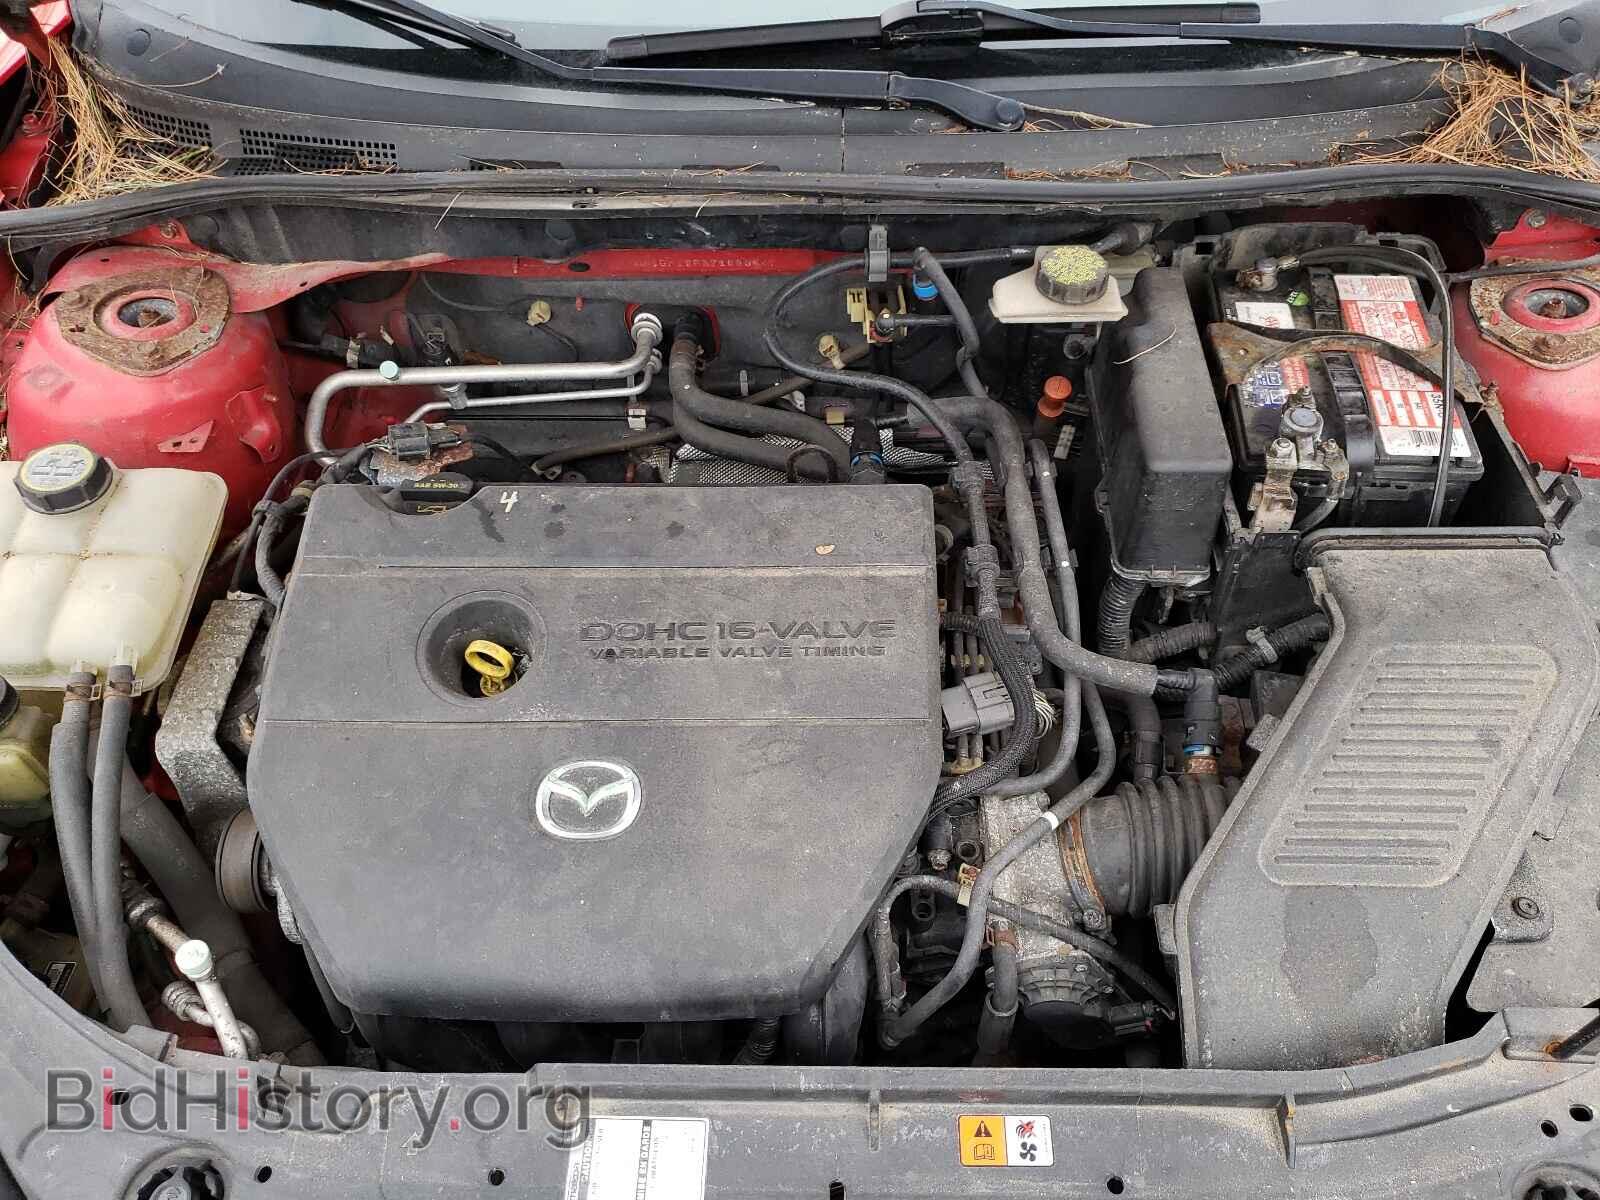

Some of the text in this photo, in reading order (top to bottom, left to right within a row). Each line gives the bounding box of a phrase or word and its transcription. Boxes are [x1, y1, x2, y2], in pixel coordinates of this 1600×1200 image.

[500, 490, 519, 513] 4
[580, 619, 897, 642] DOHC 16-VALVE
[589, 645, 887, 660] VARIABLE VALVE TIMING
